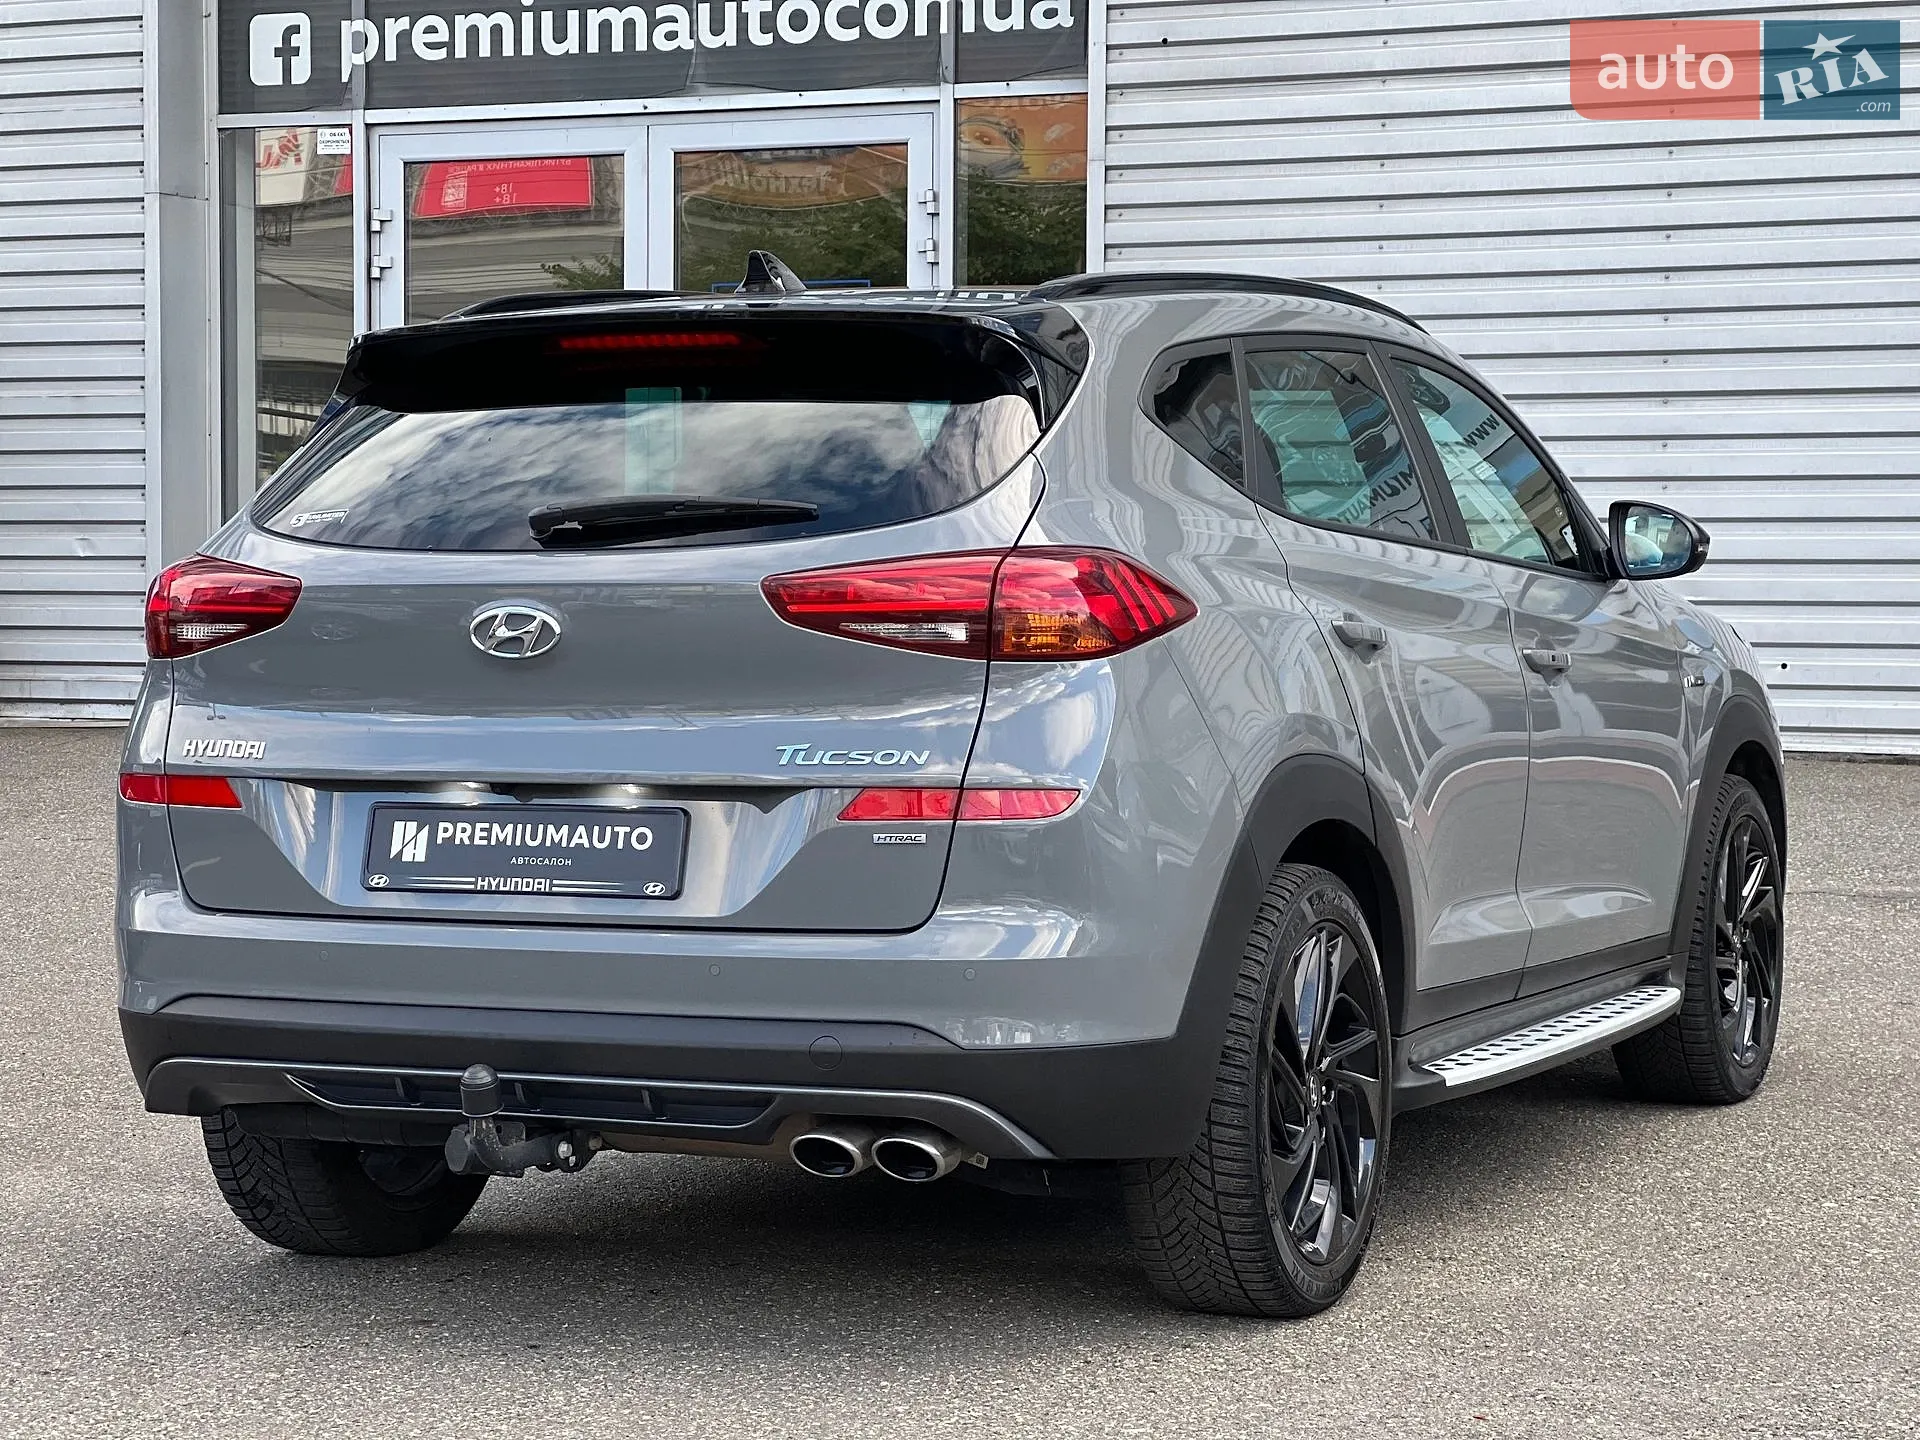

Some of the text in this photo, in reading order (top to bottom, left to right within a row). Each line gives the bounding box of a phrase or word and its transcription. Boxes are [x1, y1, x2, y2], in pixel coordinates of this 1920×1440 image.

[182, 738, 266, 760] HYUNDAI
[436, 821, 654, 851] PREMIUMAUTO
[875, 834, 923, 843] HTRAC
[510, 856, 572, 867] АВТОСАЛОН
[476, 876, 550, 892] HYUNDAI
